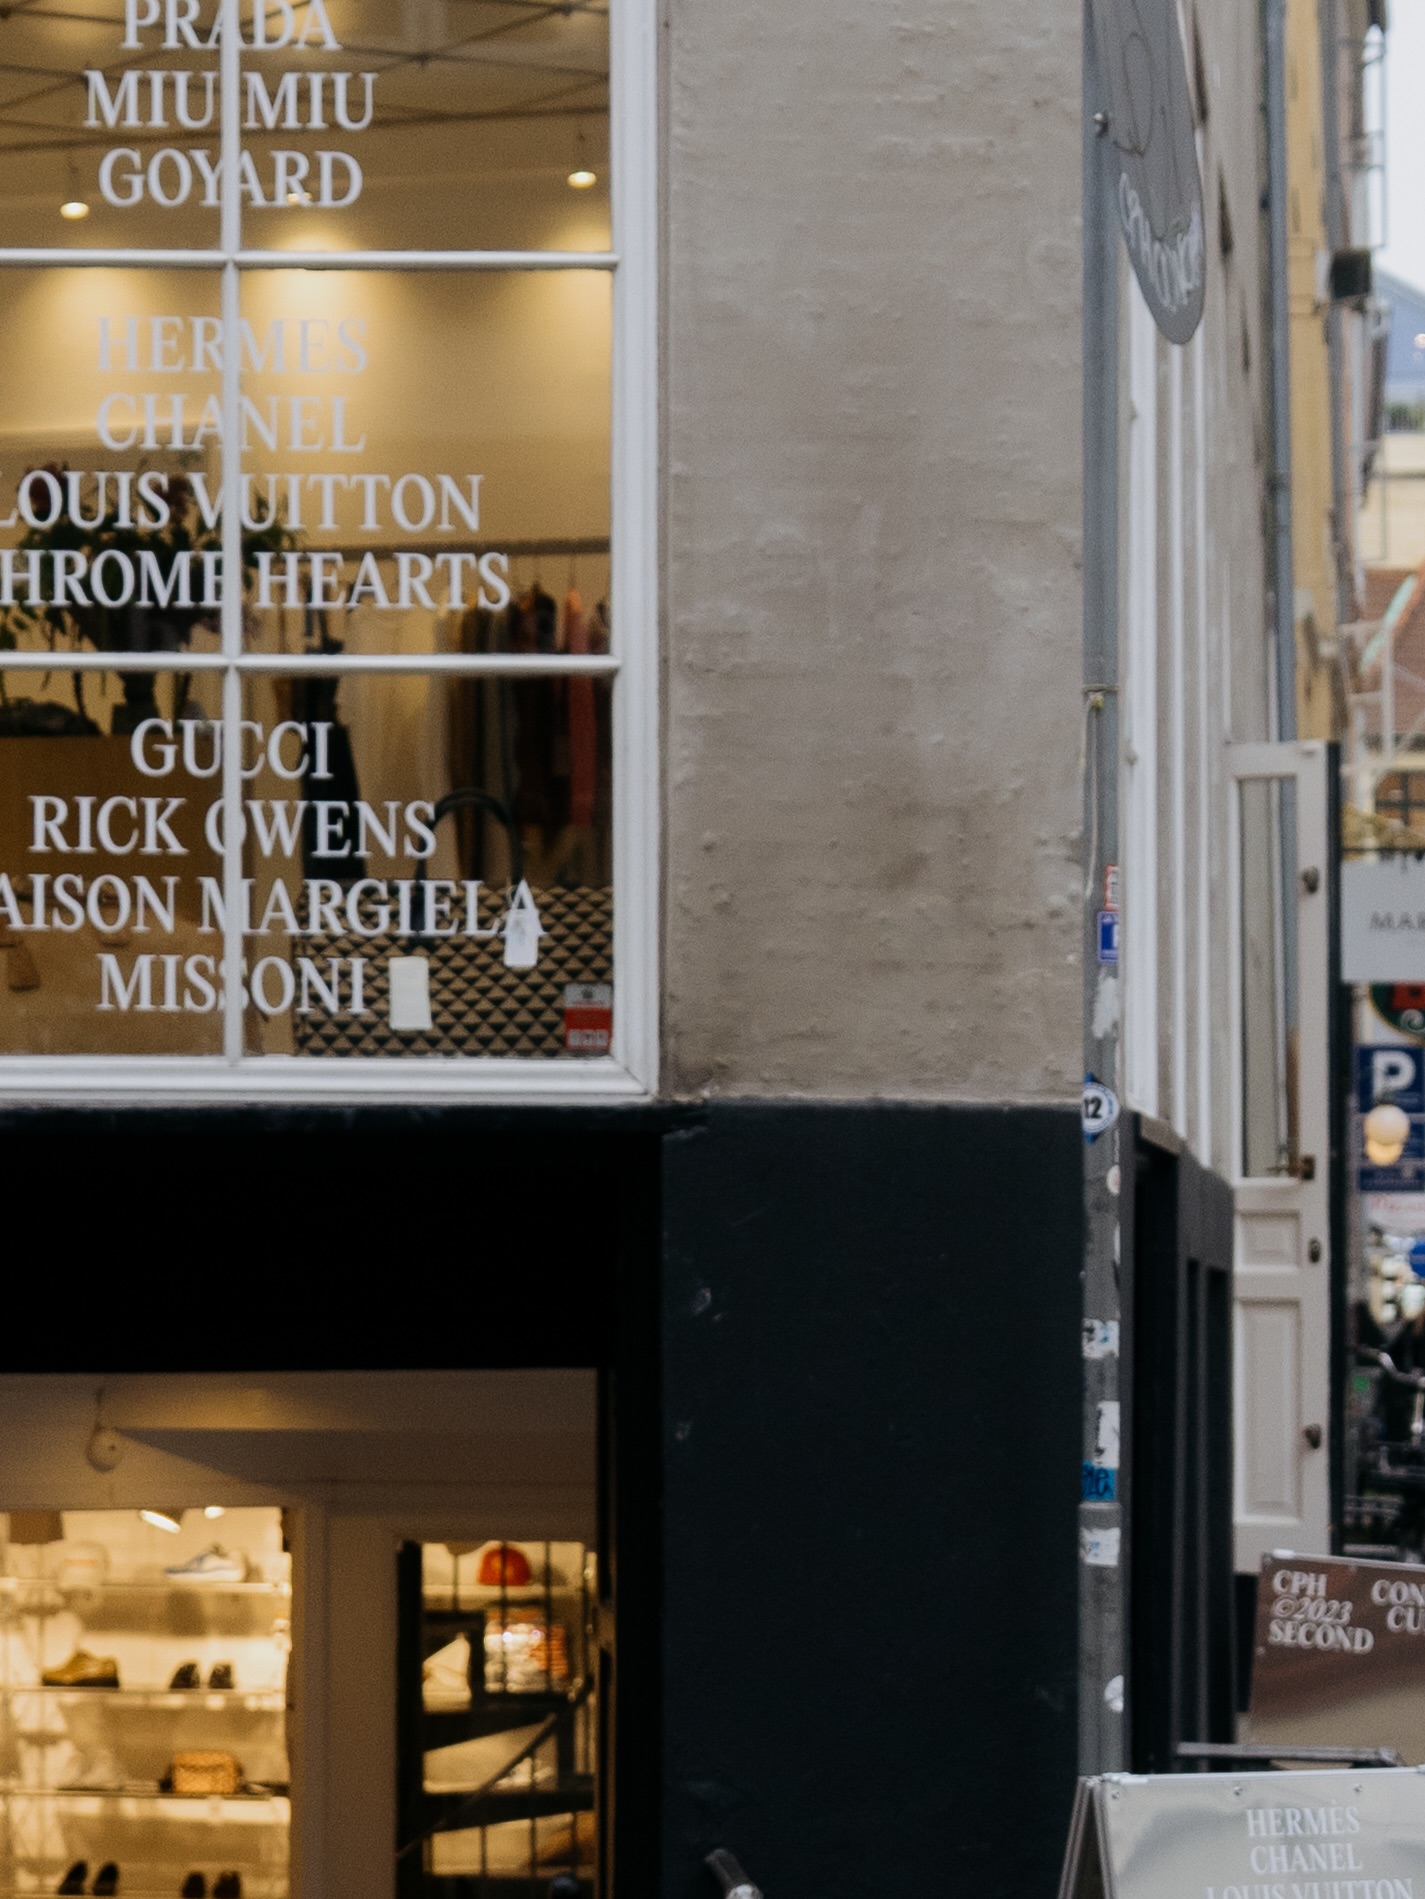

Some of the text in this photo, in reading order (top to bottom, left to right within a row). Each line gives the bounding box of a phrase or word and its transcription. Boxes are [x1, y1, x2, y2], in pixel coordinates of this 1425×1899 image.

[82, 70, 379, 131] MIU MIU
[98, 147, 364, 208] GOYARD
[95, 392, 368, 453] CHANEL
[185, 471, 484, 532] VUITTON
[252, 551, 512, 611] HEARTS
[130, 717, 334, 780] GUCCI
[28, 795, 437, 859] RICK OWENS
[197, 876, 549, 937] MARGIELA
[1273, 1569, 1327, 1595] CPH
[1268, 1618, 1375, 1654] SECOND
[1250, 1843, 1363, 1876] CHANEL
